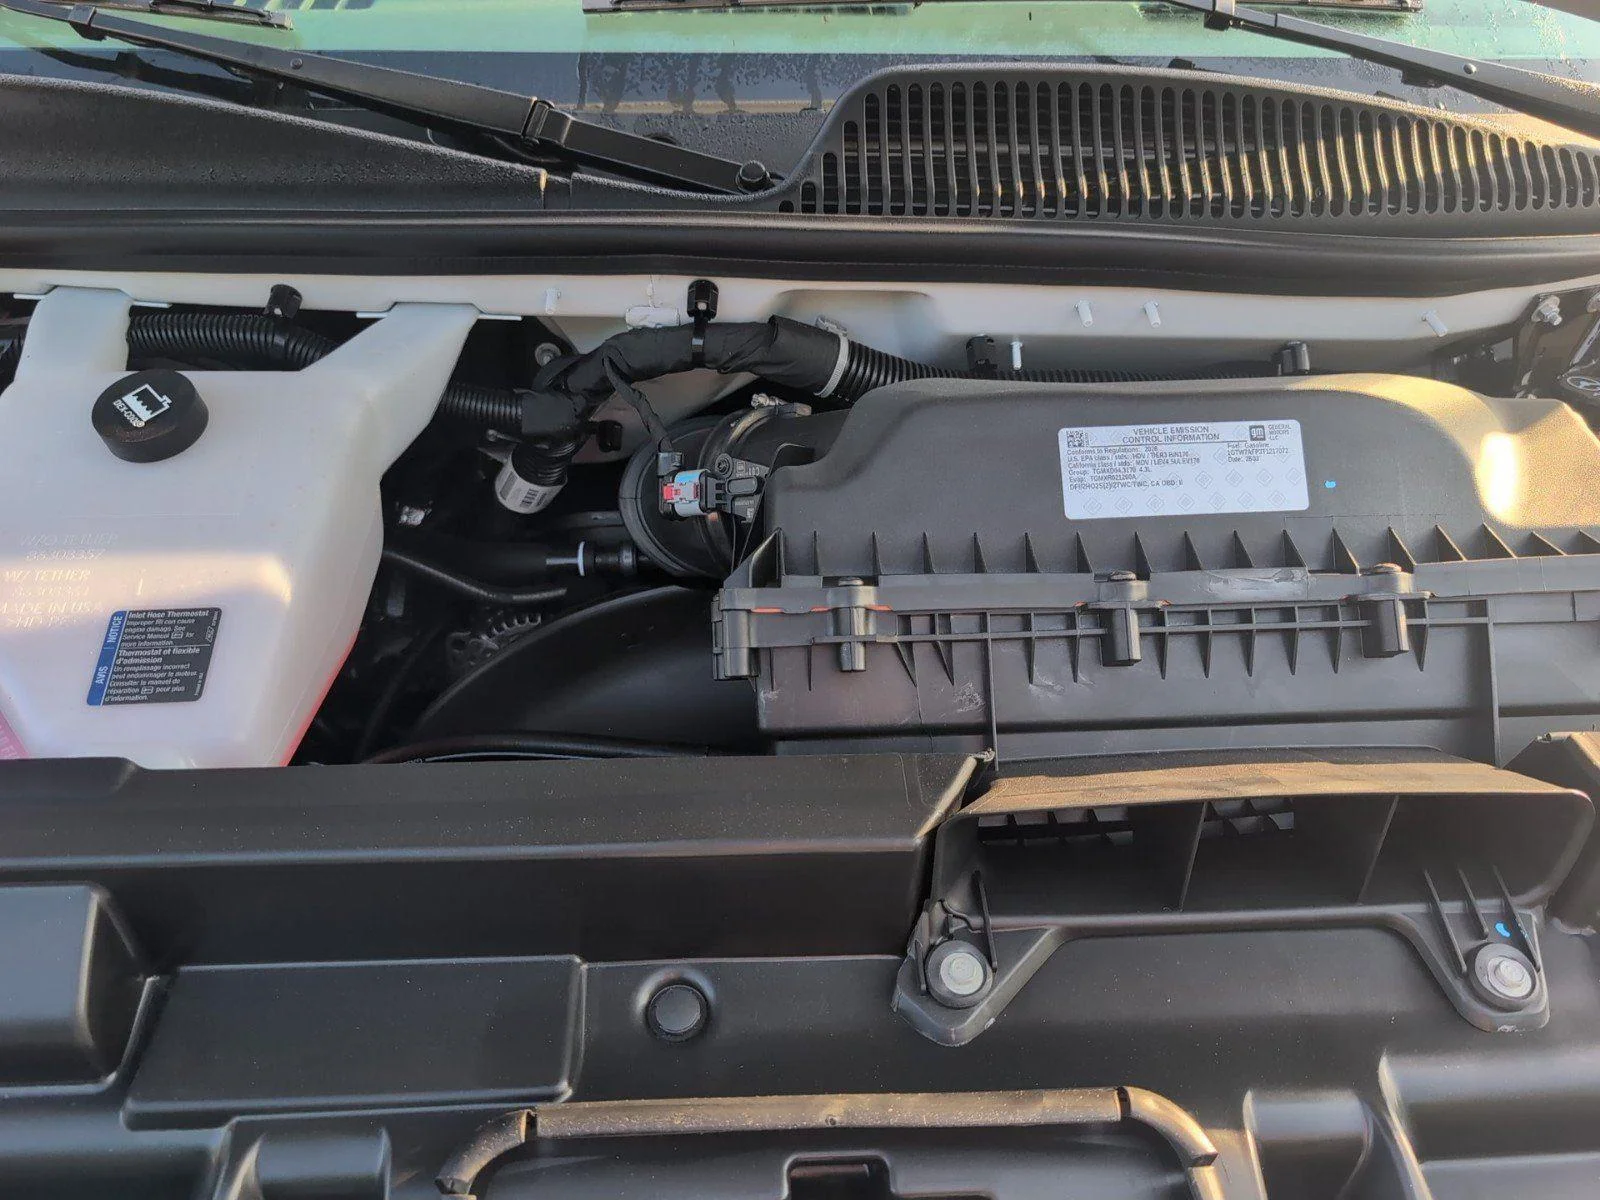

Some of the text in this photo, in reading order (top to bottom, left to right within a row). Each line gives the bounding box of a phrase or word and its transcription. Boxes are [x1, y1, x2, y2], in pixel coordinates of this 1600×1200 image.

[1133, 426, 1209, 435] VEHICLE EMISSION
[1122, 433, 1219, 443] CONTROL INFORMATION
[1104, 447, 1140, 455] Regulations:
[1068, 462, 1097, 470] California
[34, 568, 92, 581] TETHER
[107, 615, 123, 643] NOTICE
[119, 647, 161, 656] Thermostat
[172, 647, 200, 655] flexible
[116, 656, 162, 664] d'admission
[123, 665, 161, 673] remplissage
[95, 665, 109, 685] AVIS
[111, 673, 126, 681] peut
[127, 672, 167, 680] endommager
